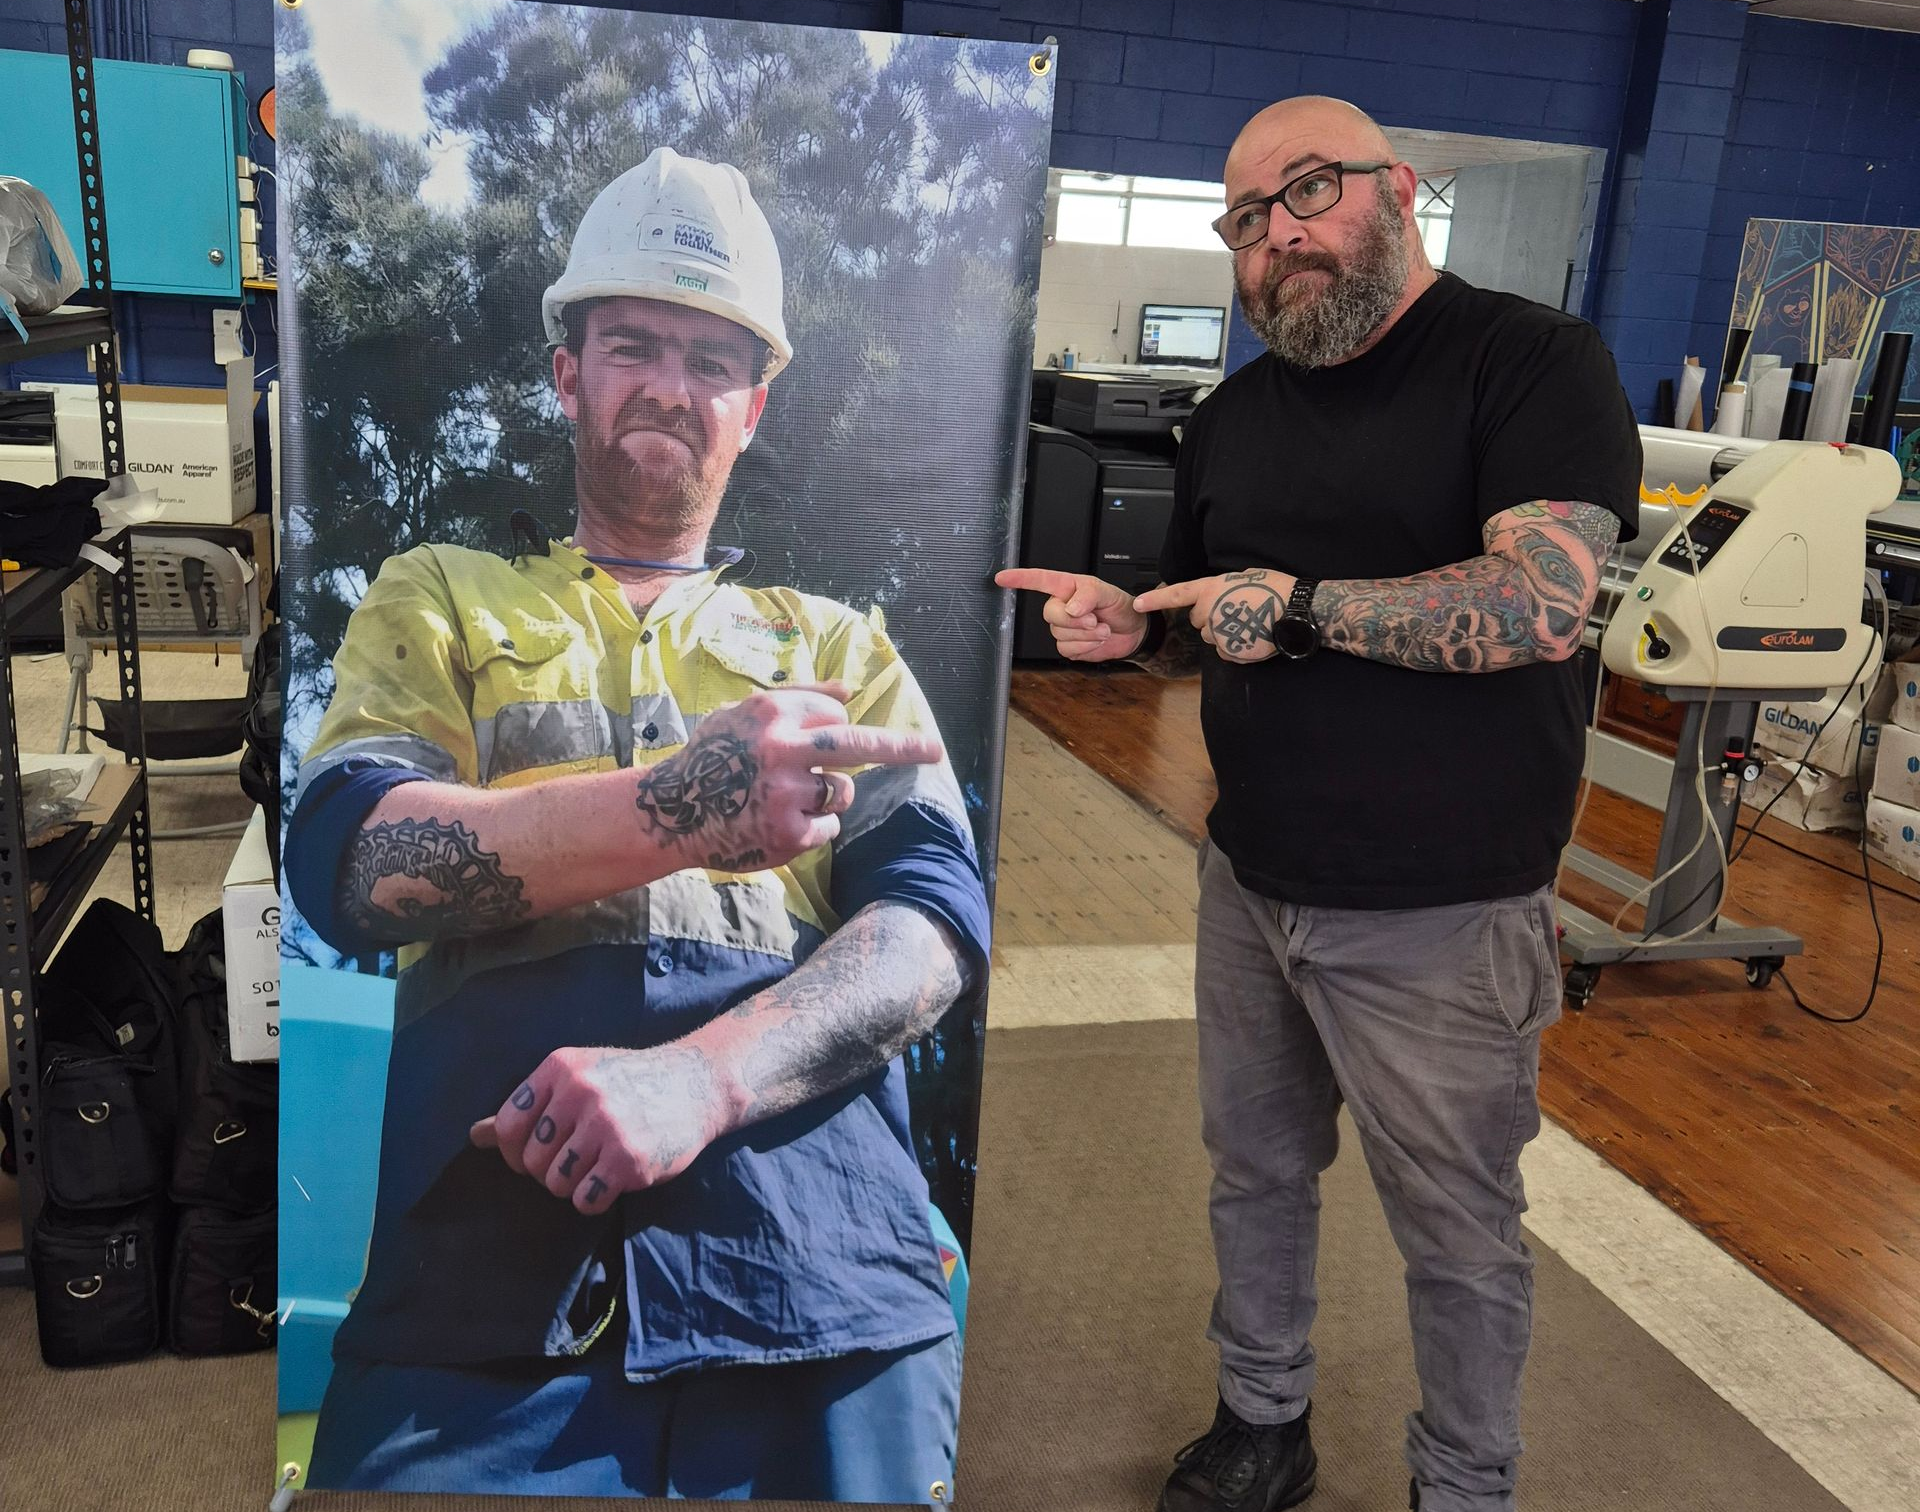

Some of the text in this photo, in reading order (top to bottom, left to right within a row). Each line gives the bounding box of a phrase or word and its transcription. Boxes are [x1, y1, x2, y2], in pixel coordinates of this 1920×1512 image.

[128, 462, 173, 474] GILDAN
[182, 463, 218, 472] American
[183, 470, 212, 479] Apparel
[1765, 707, 1822, 738] GILDAN
